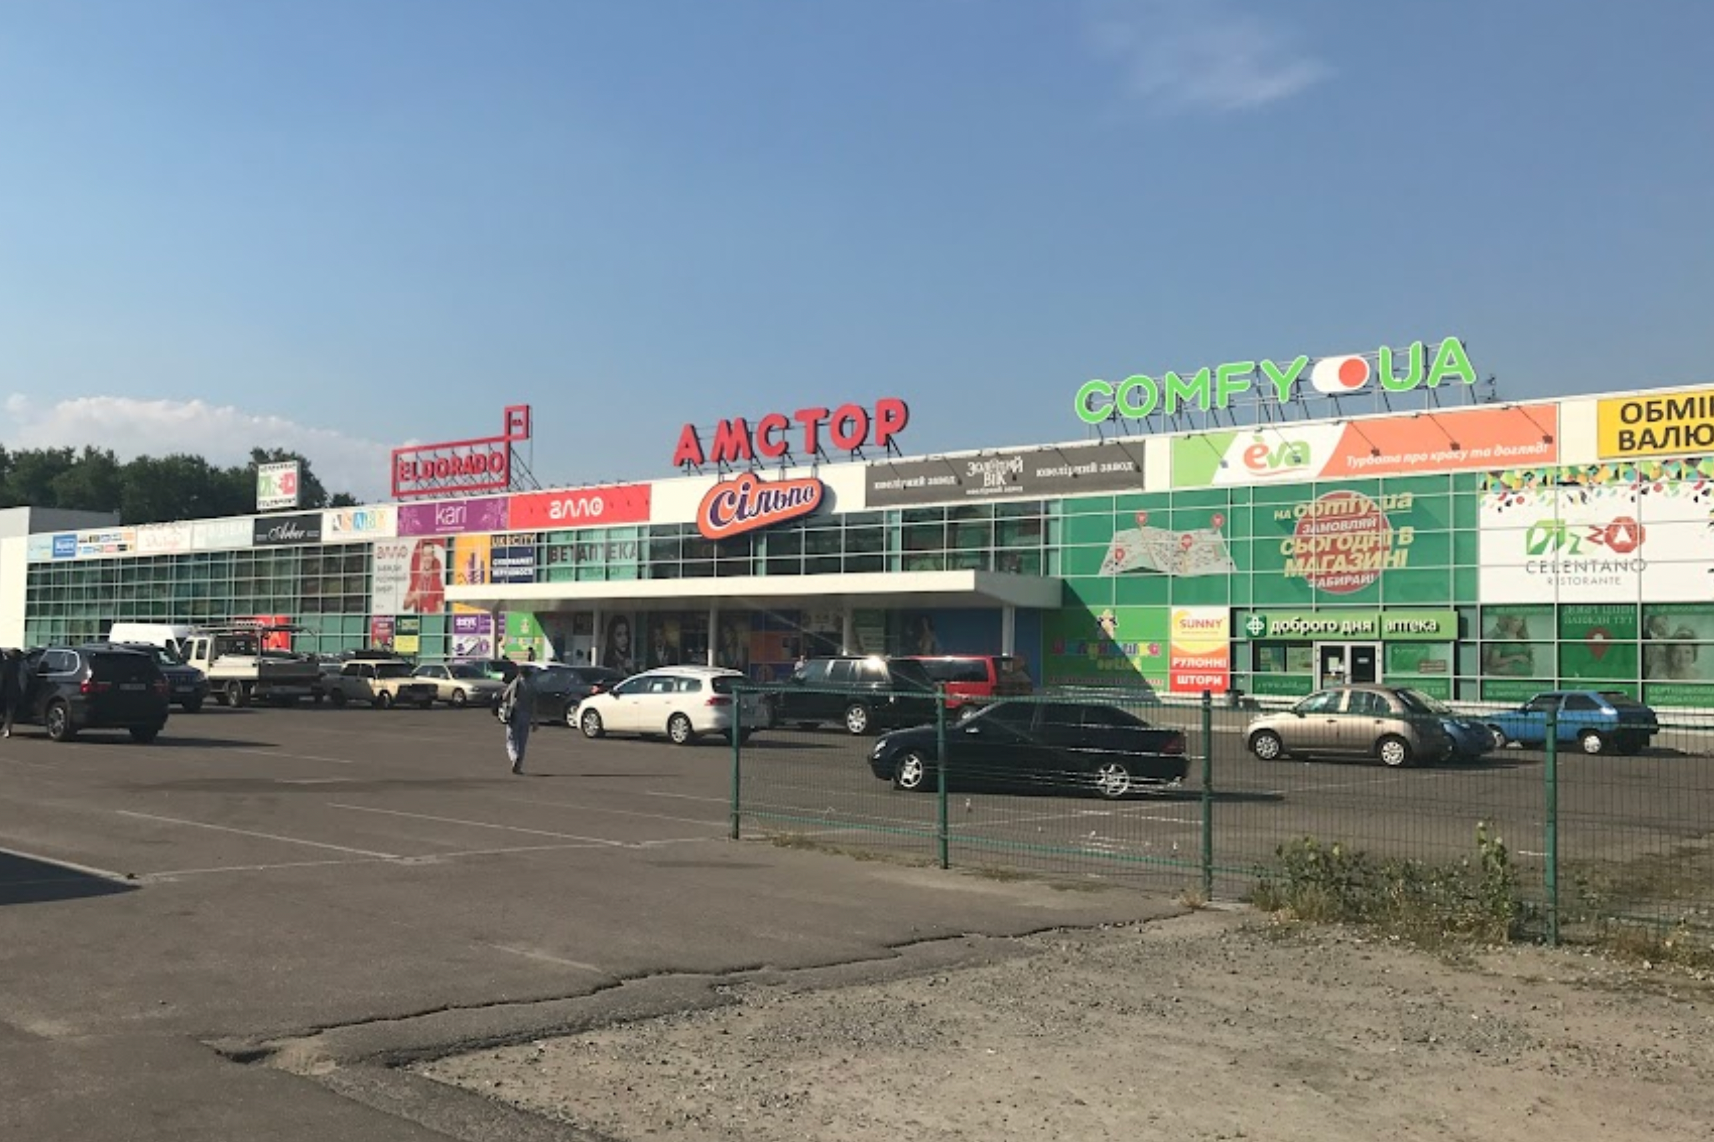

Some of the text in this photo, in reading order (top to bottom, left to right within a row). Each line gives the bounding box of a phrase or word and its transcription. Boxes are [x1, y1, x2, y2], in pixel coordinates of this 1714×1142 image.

[1075, 336, 1477, 424] COMFY UA
[673, 398, 908, 466] АМСТОР
[1619, 423, 1714, 451] ВАЛЮ
[398, 452, 504, 482] ELDORADO
[1403, 452, 1428, 464] про
[1431, 449, 1468, 463] красу
[1470, 448, 1491, 458] та
[435, 500, 467, 526] kari
[708, 480, 814, 529] Сільпо
[1284, 548, 1409, 578] МАГАЗИНІ
[1526, 558, 1648, 574] CELENTANO
[1547, 576, 1621, 585] RSTORANTE
[1178, 618, 1223, 629] SUNNY
[1271, 615, 1337, 634] доброго
[1340, 618, 1374, 634] дня
[1172, 657, 1227, 668] РУЛОННІ
[1176, 674, 1223, 685] ШТОРИ
